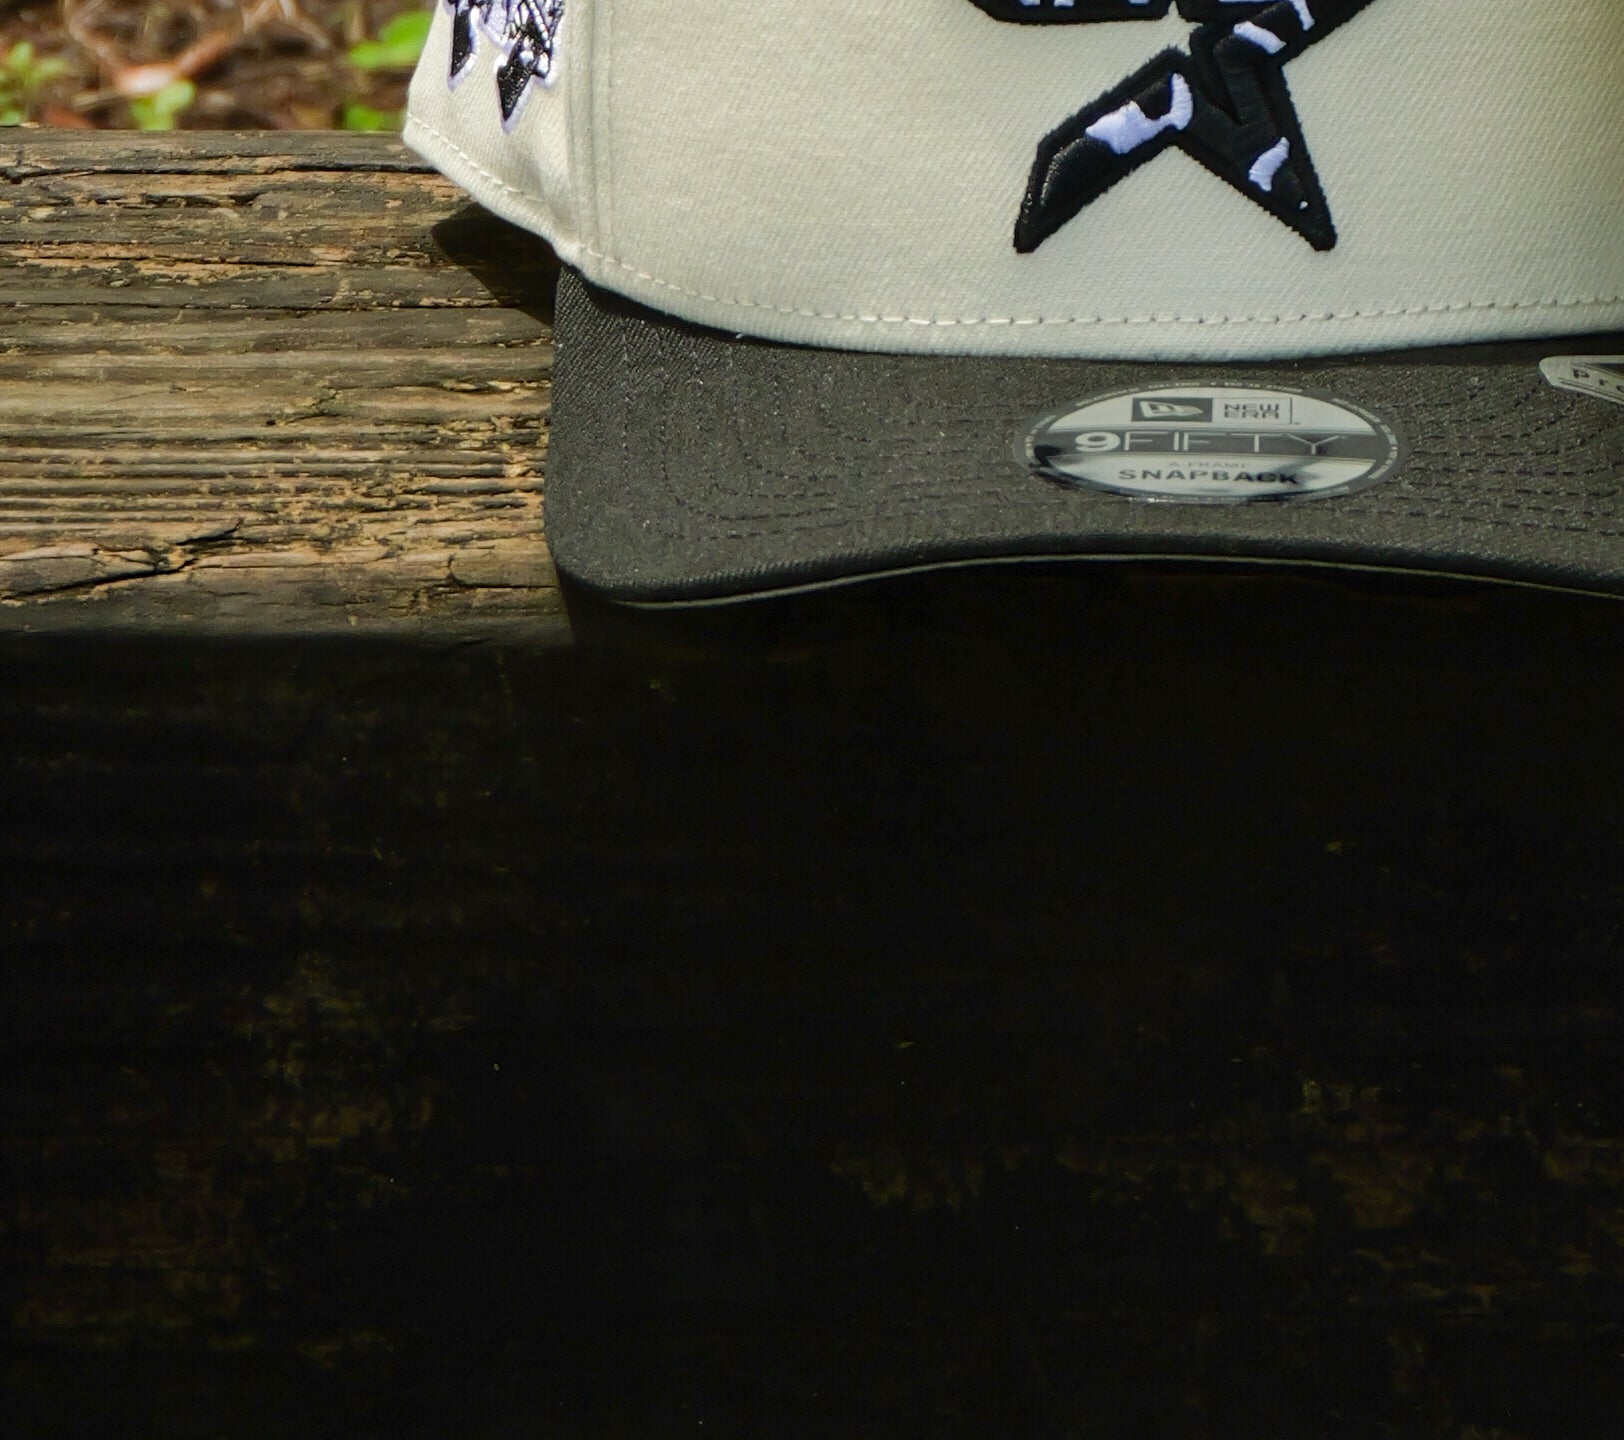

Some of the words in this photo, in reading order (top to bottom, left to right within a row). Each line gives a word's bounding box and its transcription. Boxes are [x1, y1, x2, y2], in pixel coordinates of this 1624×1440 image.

[1223, 403, 1280, 411] NEW
[1223, 411, 1280, 419] ERA
[1074, 430, 1348, 455] 9FIFTY
[1118, 469, 1299, 484] SNAPBACK
